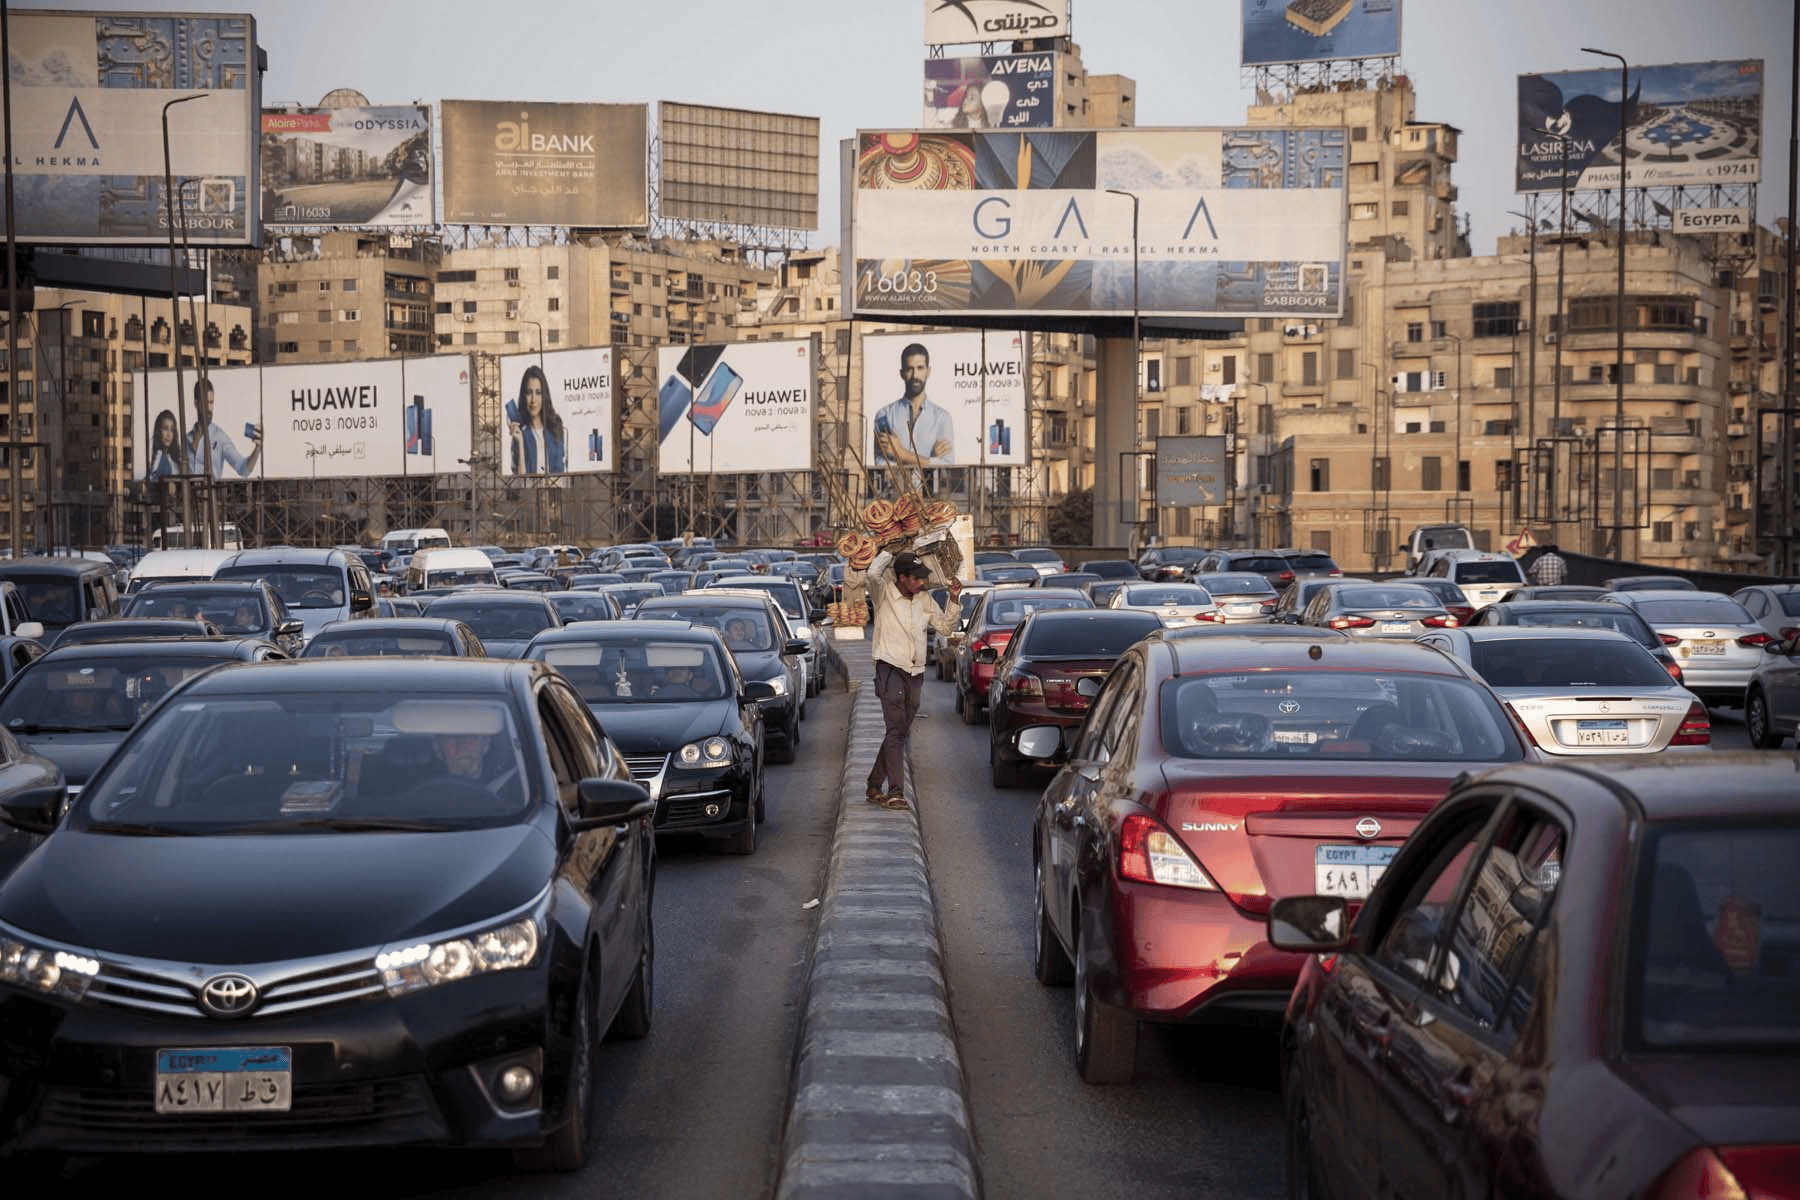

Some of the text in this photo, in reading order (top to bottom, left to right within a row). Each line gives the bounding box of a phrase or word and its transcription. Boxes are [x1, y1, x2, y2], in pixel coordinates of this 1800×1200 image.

[991, 57, 1053, 75] AVENA
[354, 119, 420, 130] ODYSSIA
[531, 133, 595, 152] BANK
[35, 156, 100, 166] HEKMA
[1717, 163, 1756, 175] 19741
[302, 206, 331, 218] 16033
[1683, 214, 1741, 226] EGYPTA
[971, 245, 1020, 253] NORTH
[1030, 245, 1079, 253] COAST
[1102, 245, 1130, 254] RAS
[1167, 246, 1219, 254] HEKMA
[865, 270, 938, 293] 16033
[1263, 296, 1327, 306] SABBOUR
[954, 362, 1021, 376] HUAWEI
[564, 375, 609, 390] HUAWEI
[291, 385, 377, 411] HUAWEI
[745, 389, 807, 405] HUAWEI
[293, 418, 322, 431] nova
[325, 418, 331, 430] 3
[338, 417, 367, 429] nova
[1182, 822, 1239, 831] SUNNY
[1326, 849, 1357, 860] EGYPT
[1326, 870, 1359, 890] ٤٨٩
[161, 1080, 222, 1105] ٨٤١٧
